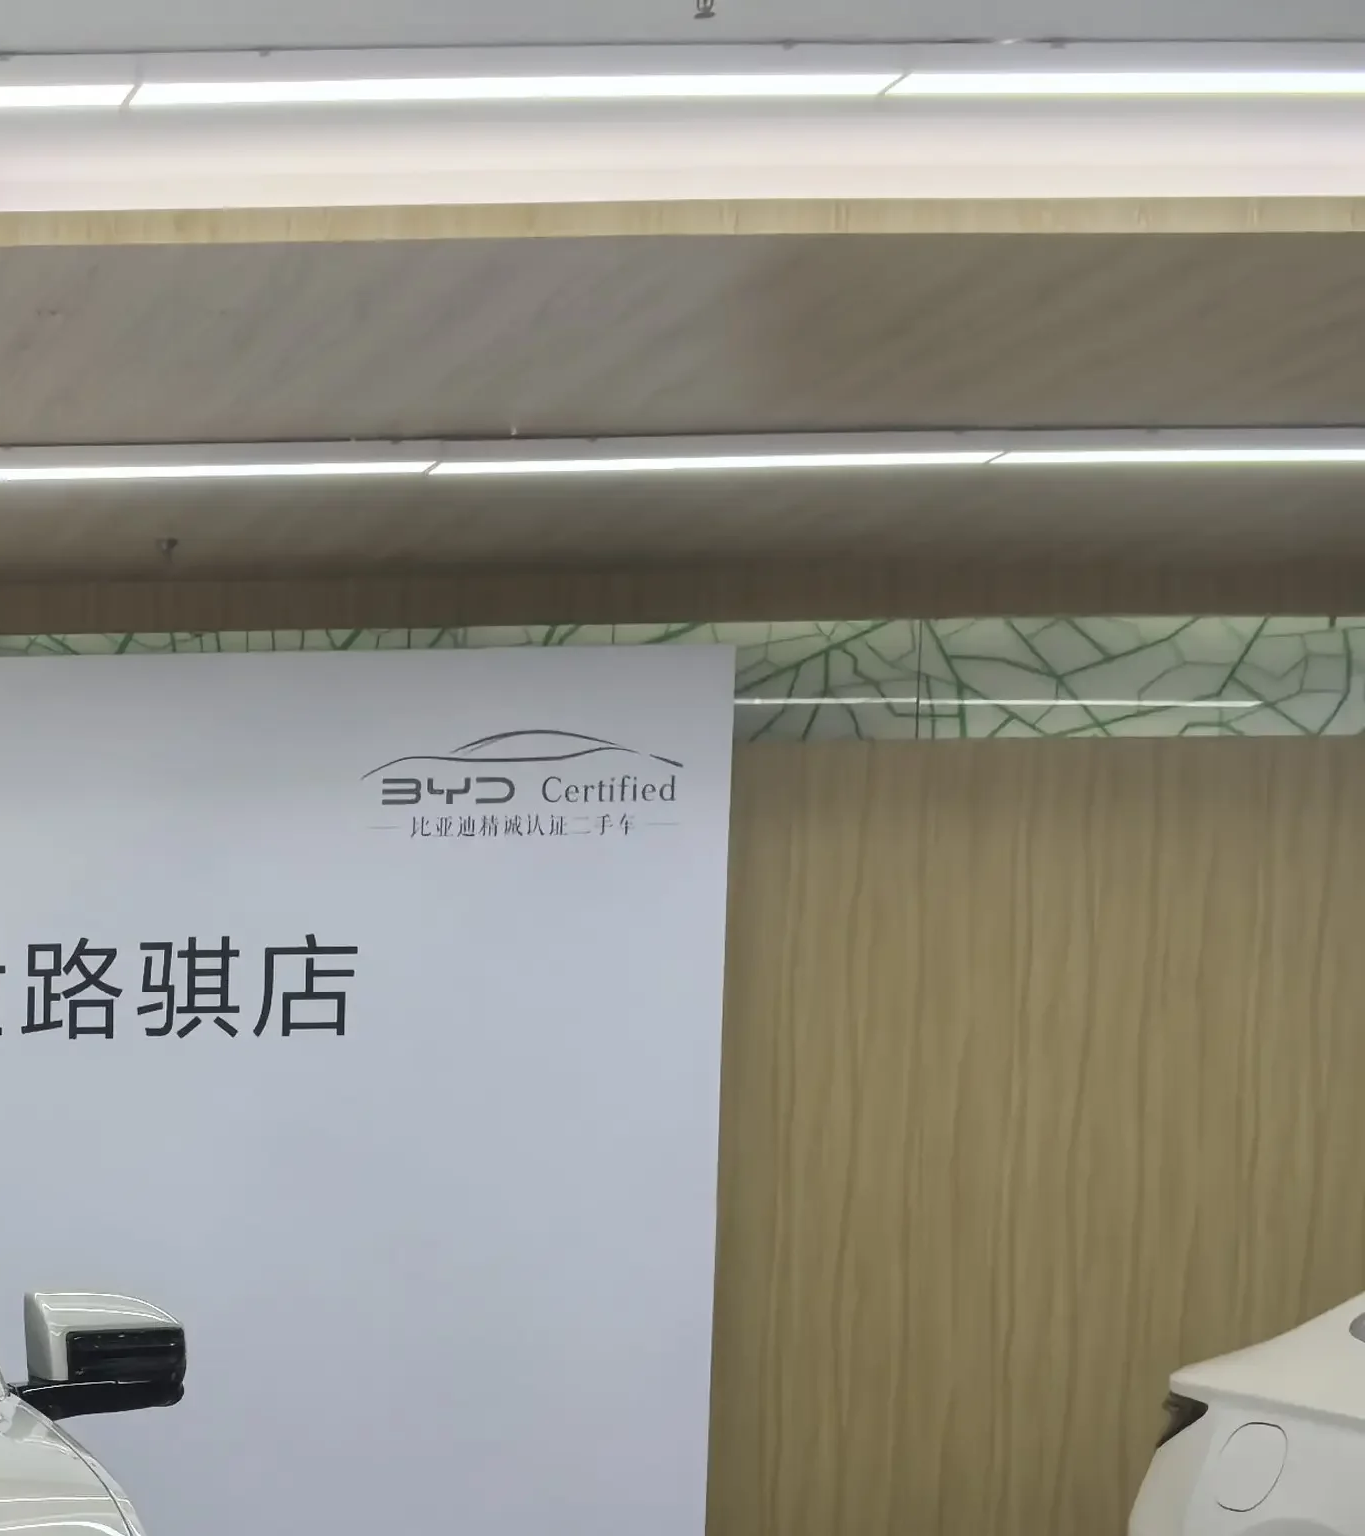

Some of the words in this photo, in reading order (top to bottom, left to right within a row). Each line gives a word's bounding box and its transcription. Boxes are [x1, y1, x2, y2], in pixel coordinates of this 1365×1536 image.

[381, 776, 517, 806] BYD
[541, 774, 677, 804] Certified
[409, 812, 636, 839] 比亚迪精诚认证二手车
